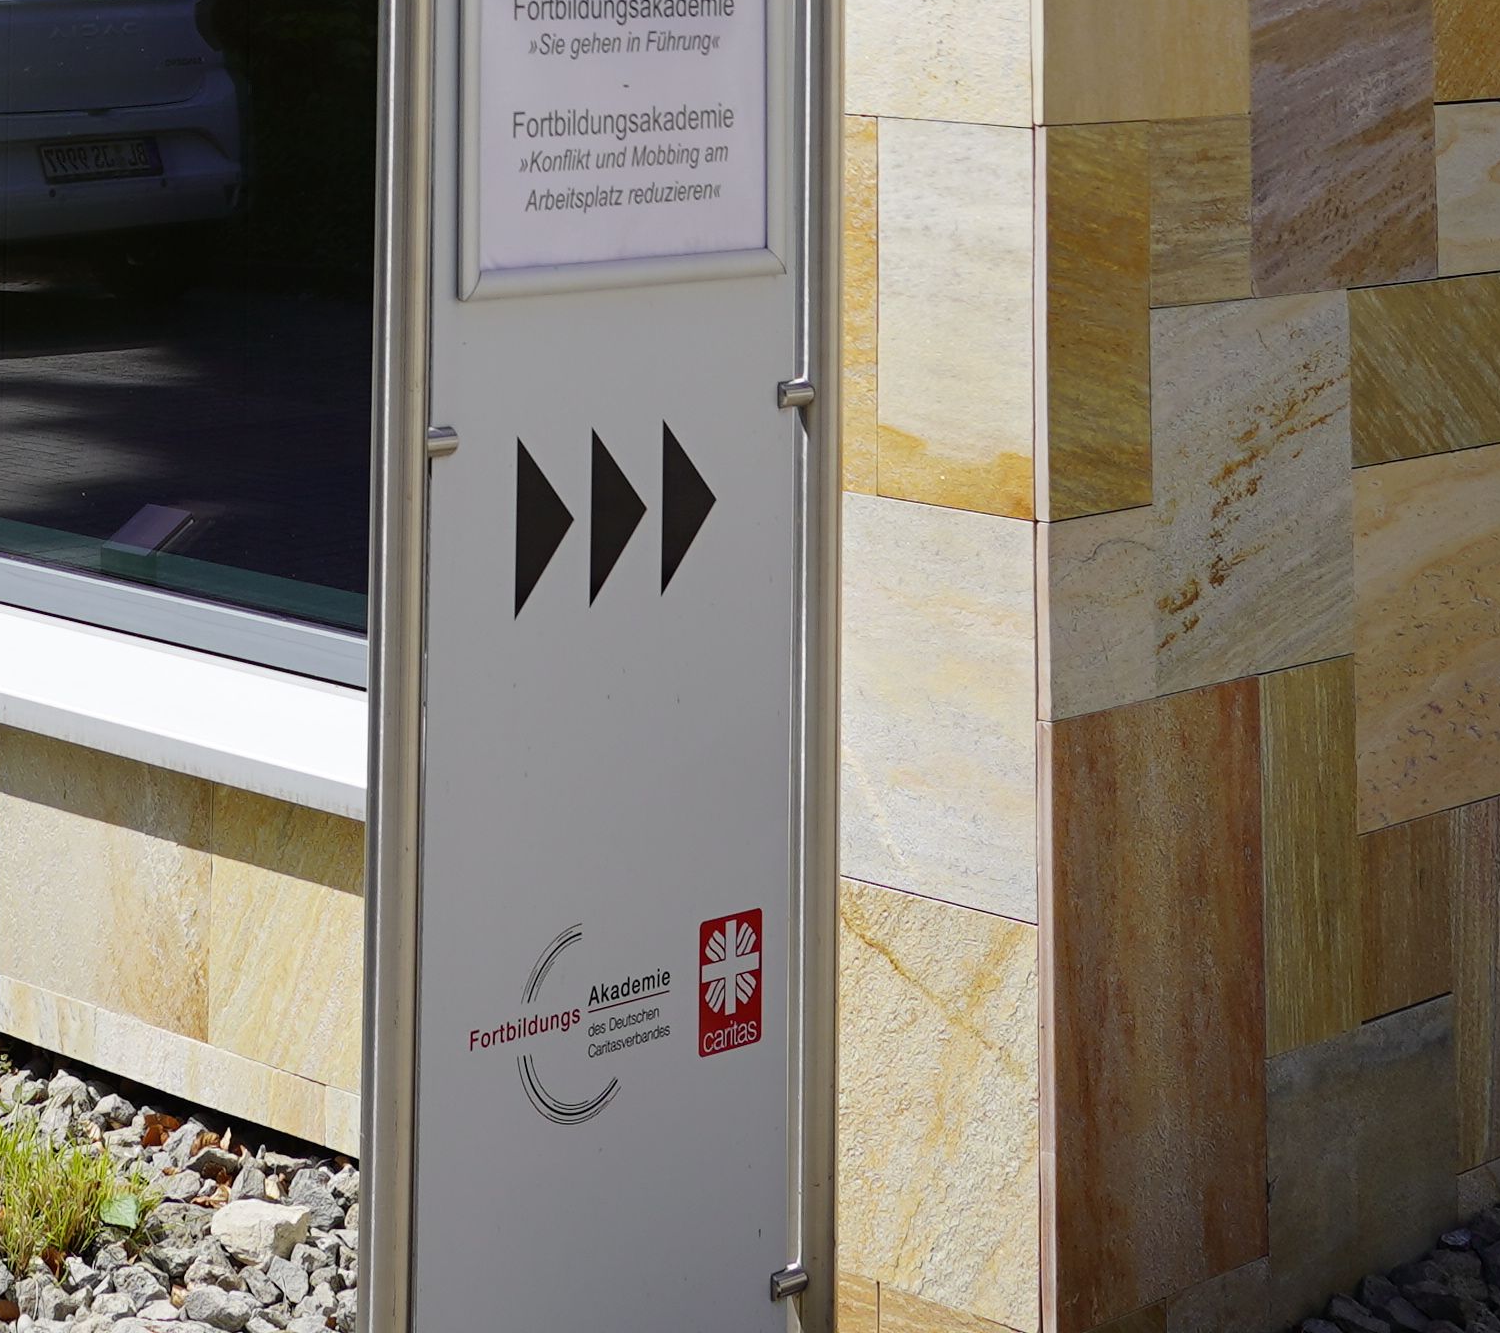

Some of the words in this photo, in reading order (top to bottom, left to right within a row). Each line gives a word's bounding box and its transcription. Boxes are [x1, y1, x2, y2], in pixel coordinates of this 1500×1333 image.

[528, 32, 566, 56] »Sie
[569, 31, 622, 61] gehen
[625, 31, 642, 53] in
[645, 29, 721, 57] Führung«
[512, 102, 735, 141] Fortbildungsakademie
[518, 148, 592, 174] »Konflikt
[595, 145, 628, 170] und
[630, 142, 701, 170] Mobbing
[703, 145, 730, 164] am
[524, 184, 624, 214] Arbeitsplatz
[627, 180, 722, 206] reduzieren«
[587, 967, 671, 1007] Akademie
[468, 1007, 581, 1052] Fortbildungs
[587, 1022, 606, 1037] des
[609, 1007, 660, 1032] Deutschen
[703, 1019, 758, 1053] caritas
[587, 1025, 671, 1058] Caritasverbandes
